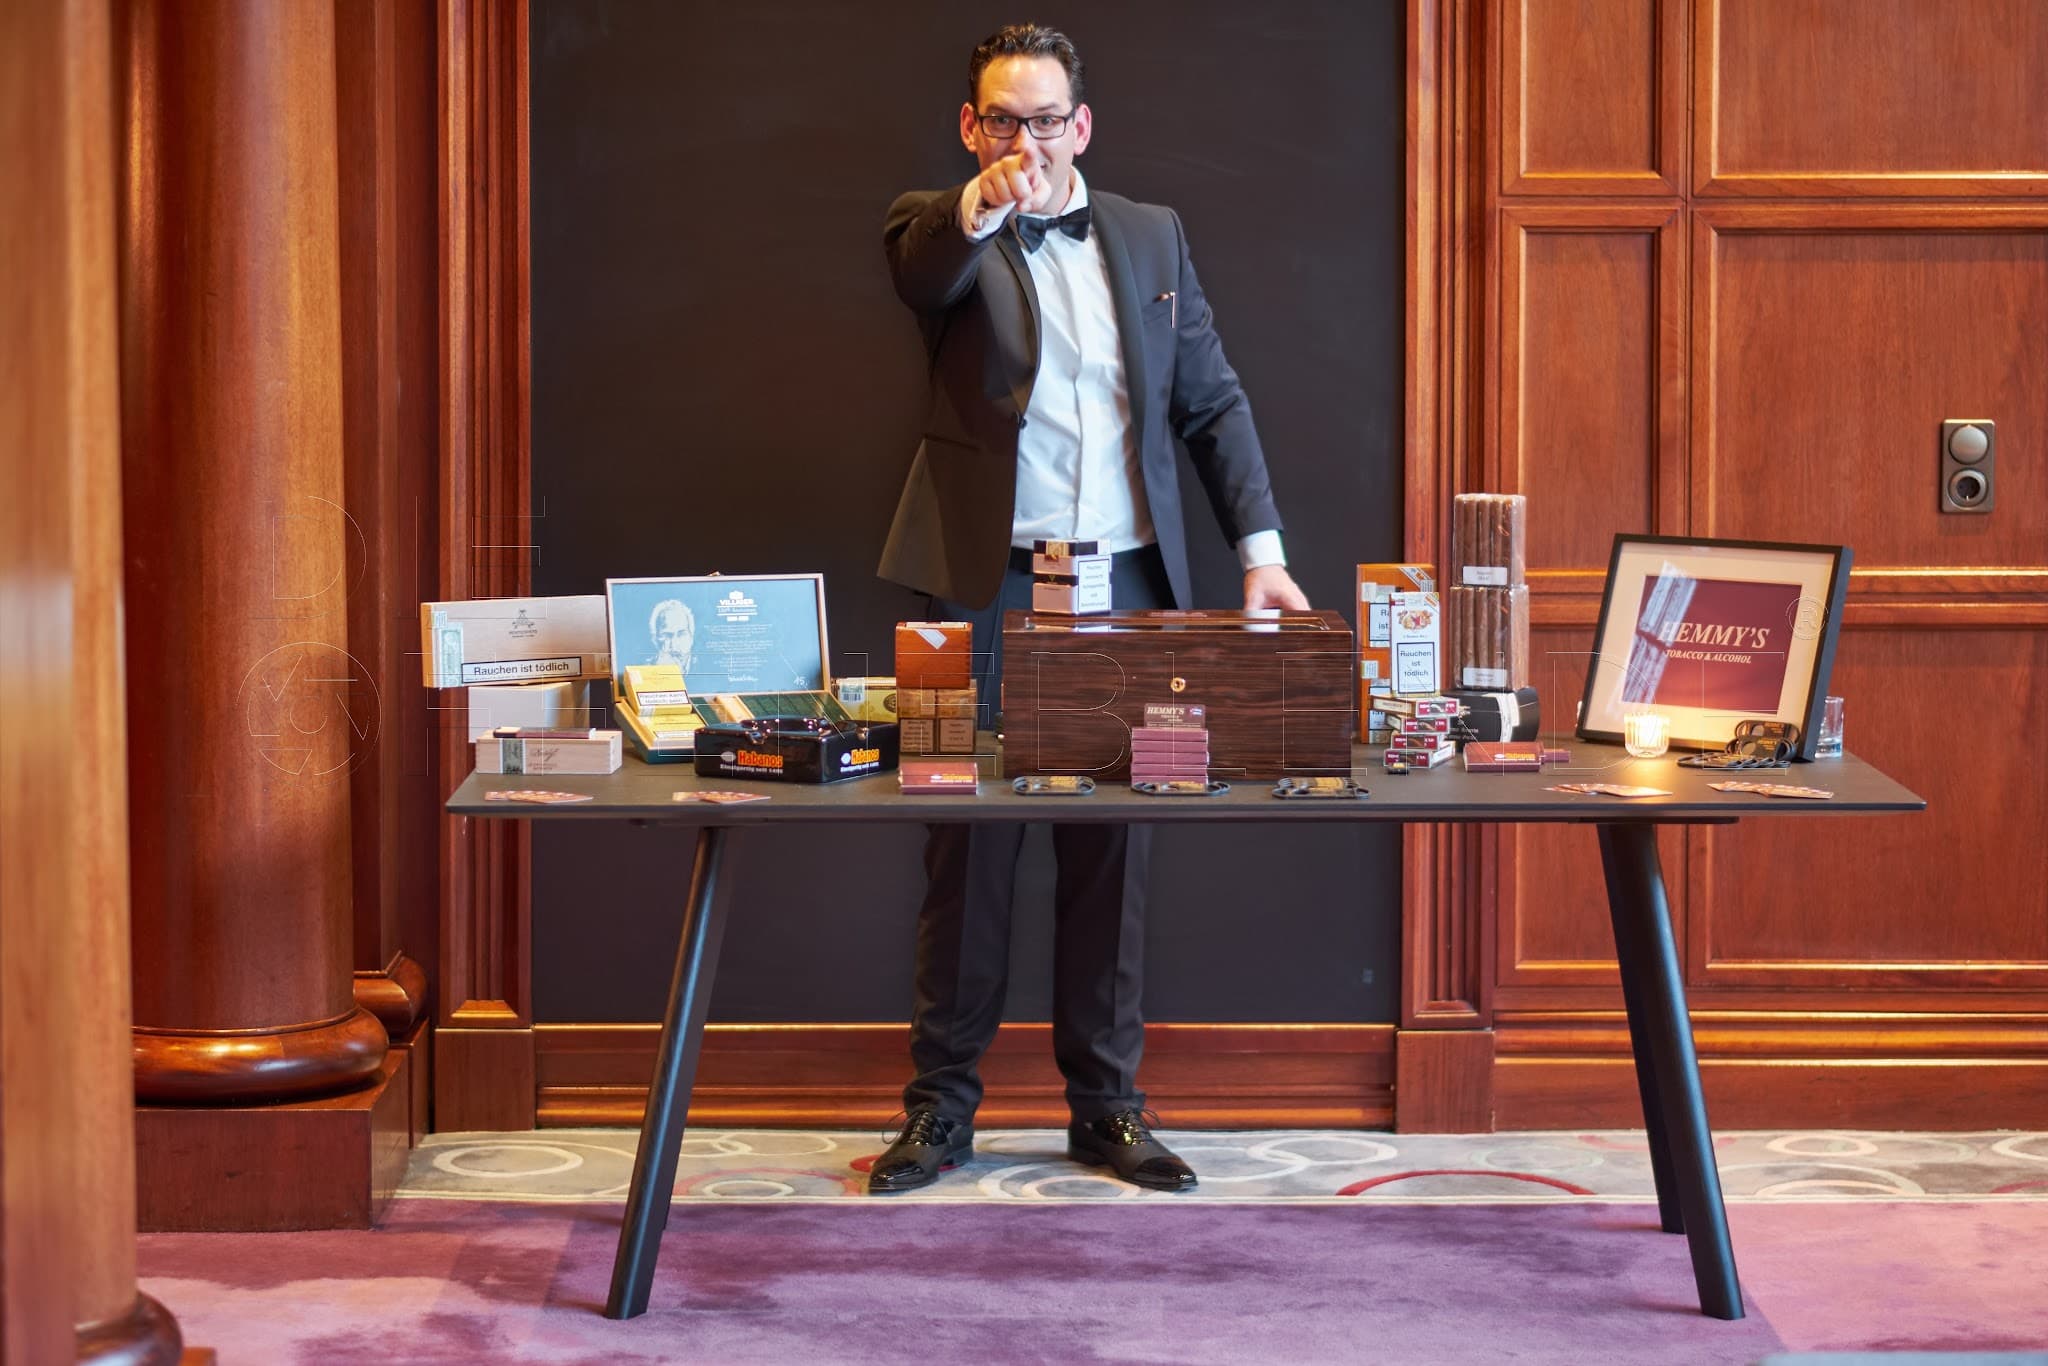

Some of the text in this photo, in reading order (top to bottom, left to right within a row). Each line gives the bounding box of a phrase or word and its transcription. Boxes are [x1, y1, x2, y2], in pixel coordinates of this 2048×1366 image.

[1657, 621, 1771, 649] HEMMY'S
[1665, 649, 1752, 664] TOBACCO & ALCOHOL
[474, 661, 569, 676] Rauchen ist tödlich
[1147, 706, 1185, 715] HEMMY'S
[737, 749, 783, 768] Habanos
